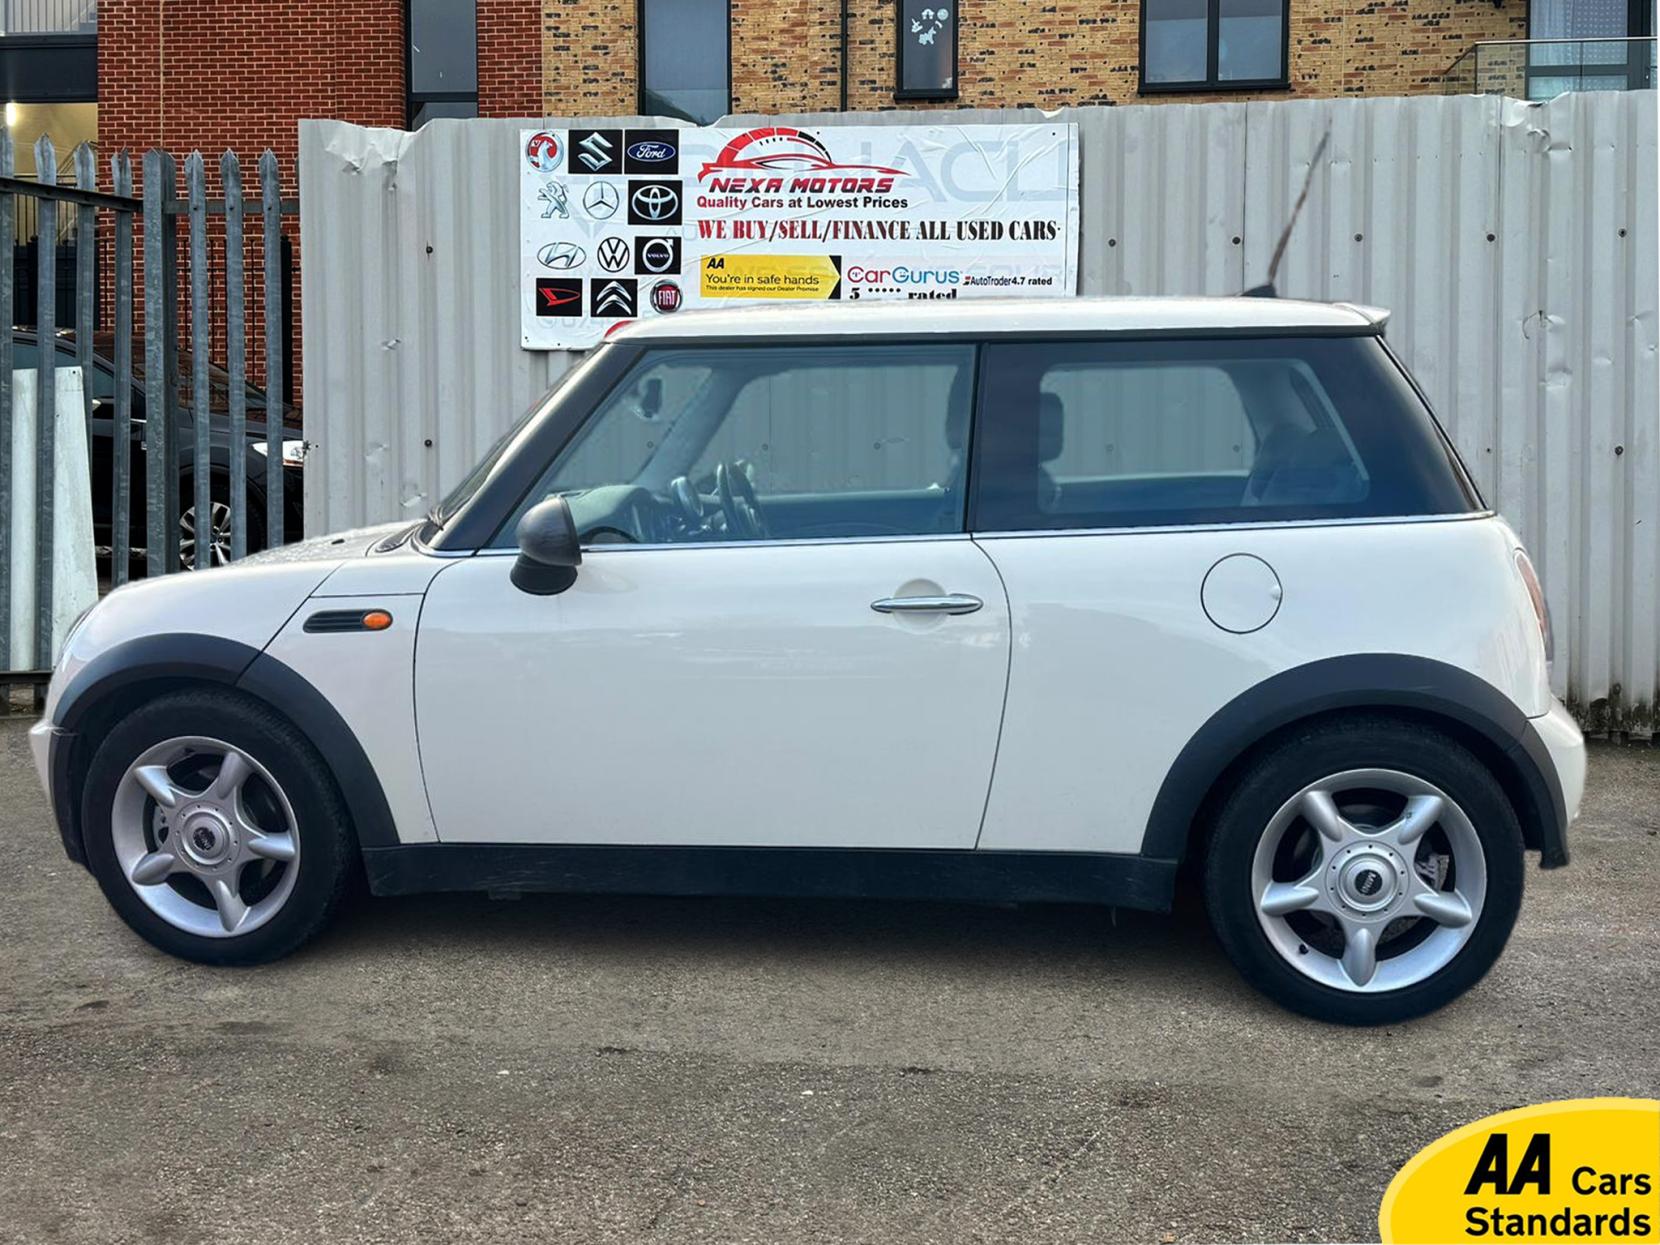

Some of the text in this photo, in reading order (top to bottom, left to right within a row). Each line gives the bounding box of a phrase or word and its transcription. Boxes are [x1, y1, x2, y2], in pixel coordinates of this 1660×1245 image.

[636, 144, 666, 159] Ford
[709, 178, 894, 193] NEXA MOTORS
[697, 196, 908, 210] Quality Cars at Lowest Prices
[697, 220, 726, 239] WE
[916, 221, 950, 240] ALL
[956, 221, 1003, 240] USED
[1009, 221, 1056, 240] CARS
[706, 257, 725, 269] AA
[706, 274, 820, 285] You're in safe hands
[847, 266, 960, 284] CarGurus
[1028, 276, 1053, 286] rated
[658, 290, 676, 306] FIAT
[849, 288, 957, 300] 5 rated
